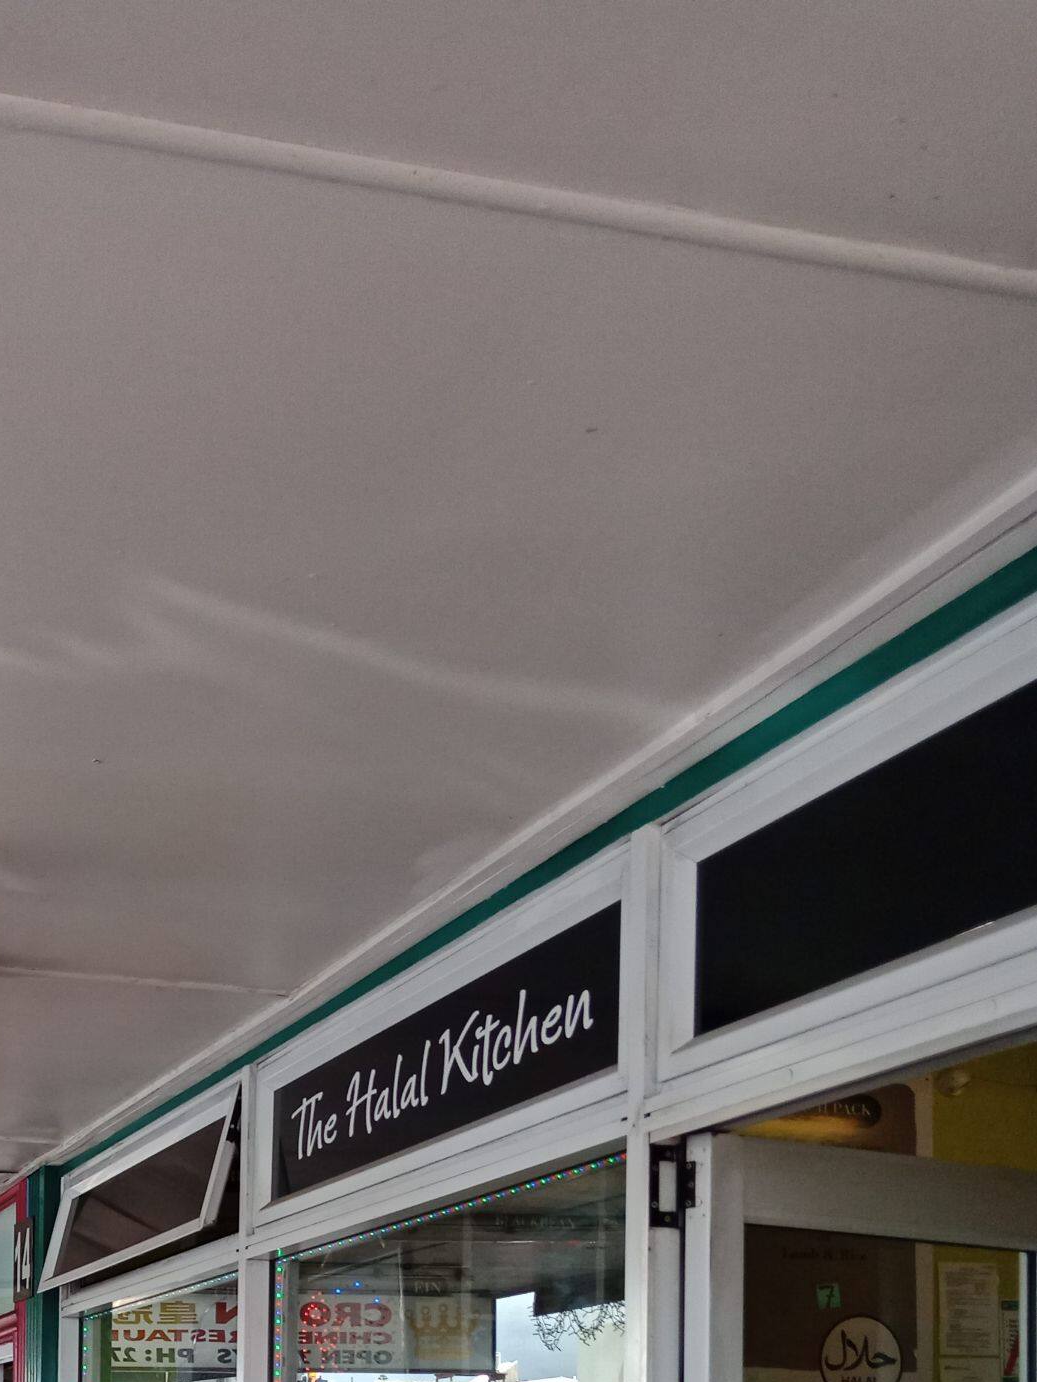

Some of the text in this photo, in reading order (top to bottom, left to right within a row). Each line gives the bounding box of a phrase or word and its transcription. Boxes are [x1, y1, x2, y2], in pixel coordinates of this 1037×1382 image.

[291, 989, 594, 1160] The Halal Kitchen
[14, 1227, 31, 1293] 14
[825, 1329, 897, 1371] حلال
